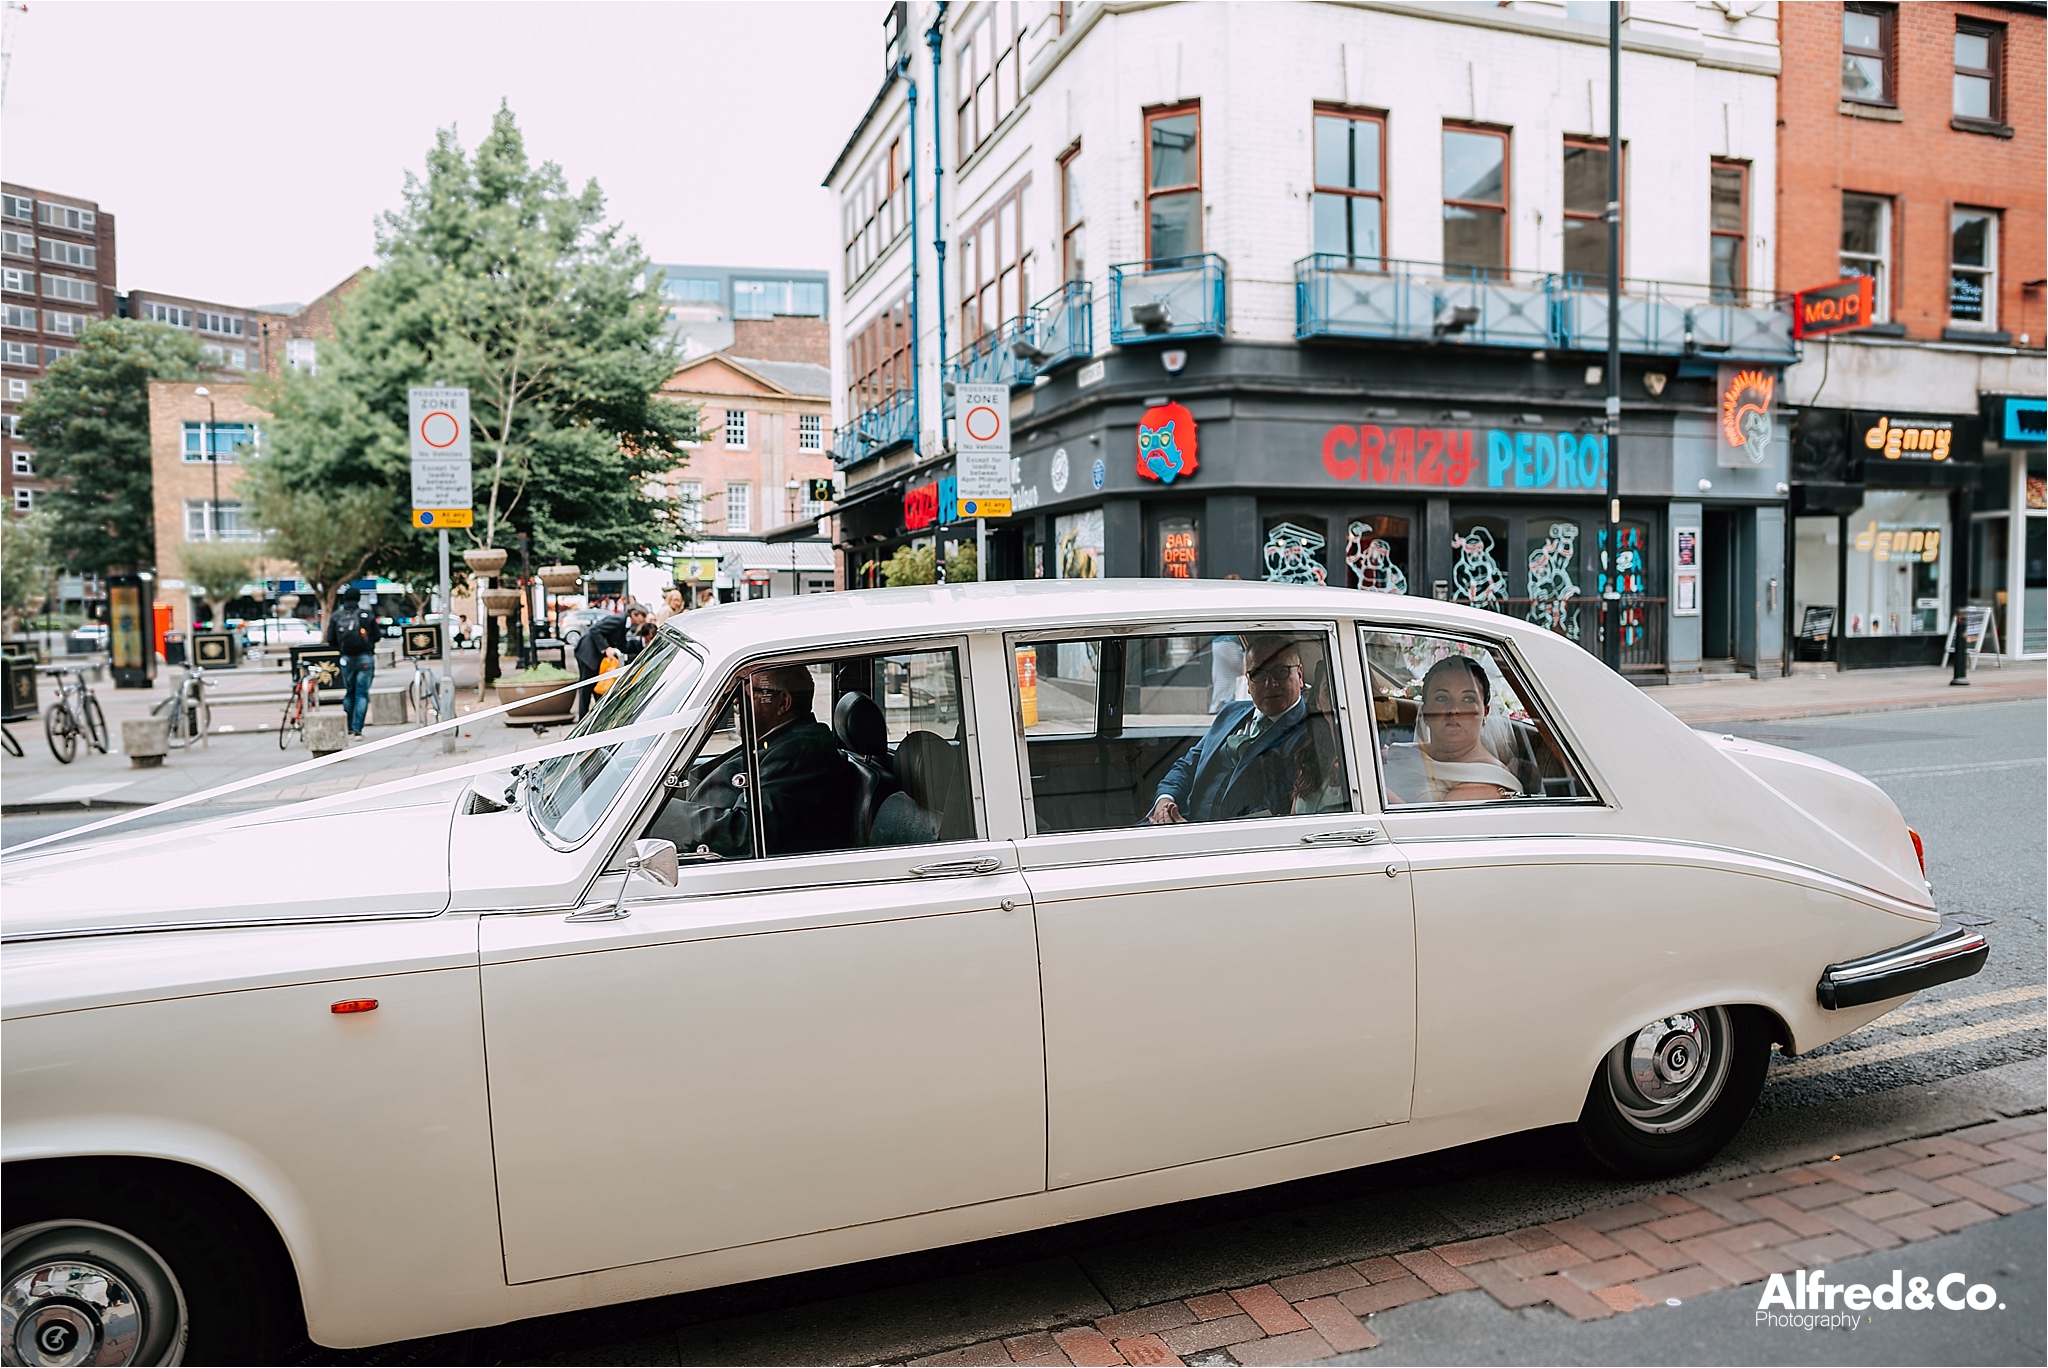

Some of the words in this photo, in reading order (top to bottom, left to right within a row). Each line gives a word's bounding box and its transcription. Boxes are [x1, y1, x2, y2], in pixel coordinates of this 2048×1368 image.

[1805, 294, 1860, 324] MOJO
[421, 399, 457, 409] ZONE
[966, 394, 998, 404] ZONE
[1865, 416, 1951, 460] denny
[1322, 425, 1479, 487] CRAZY
[1166, 533, 1193, 548] BAR
[1855, 521, 1940, 562] denny
[1164, 547, 1196, 563] OPEN
